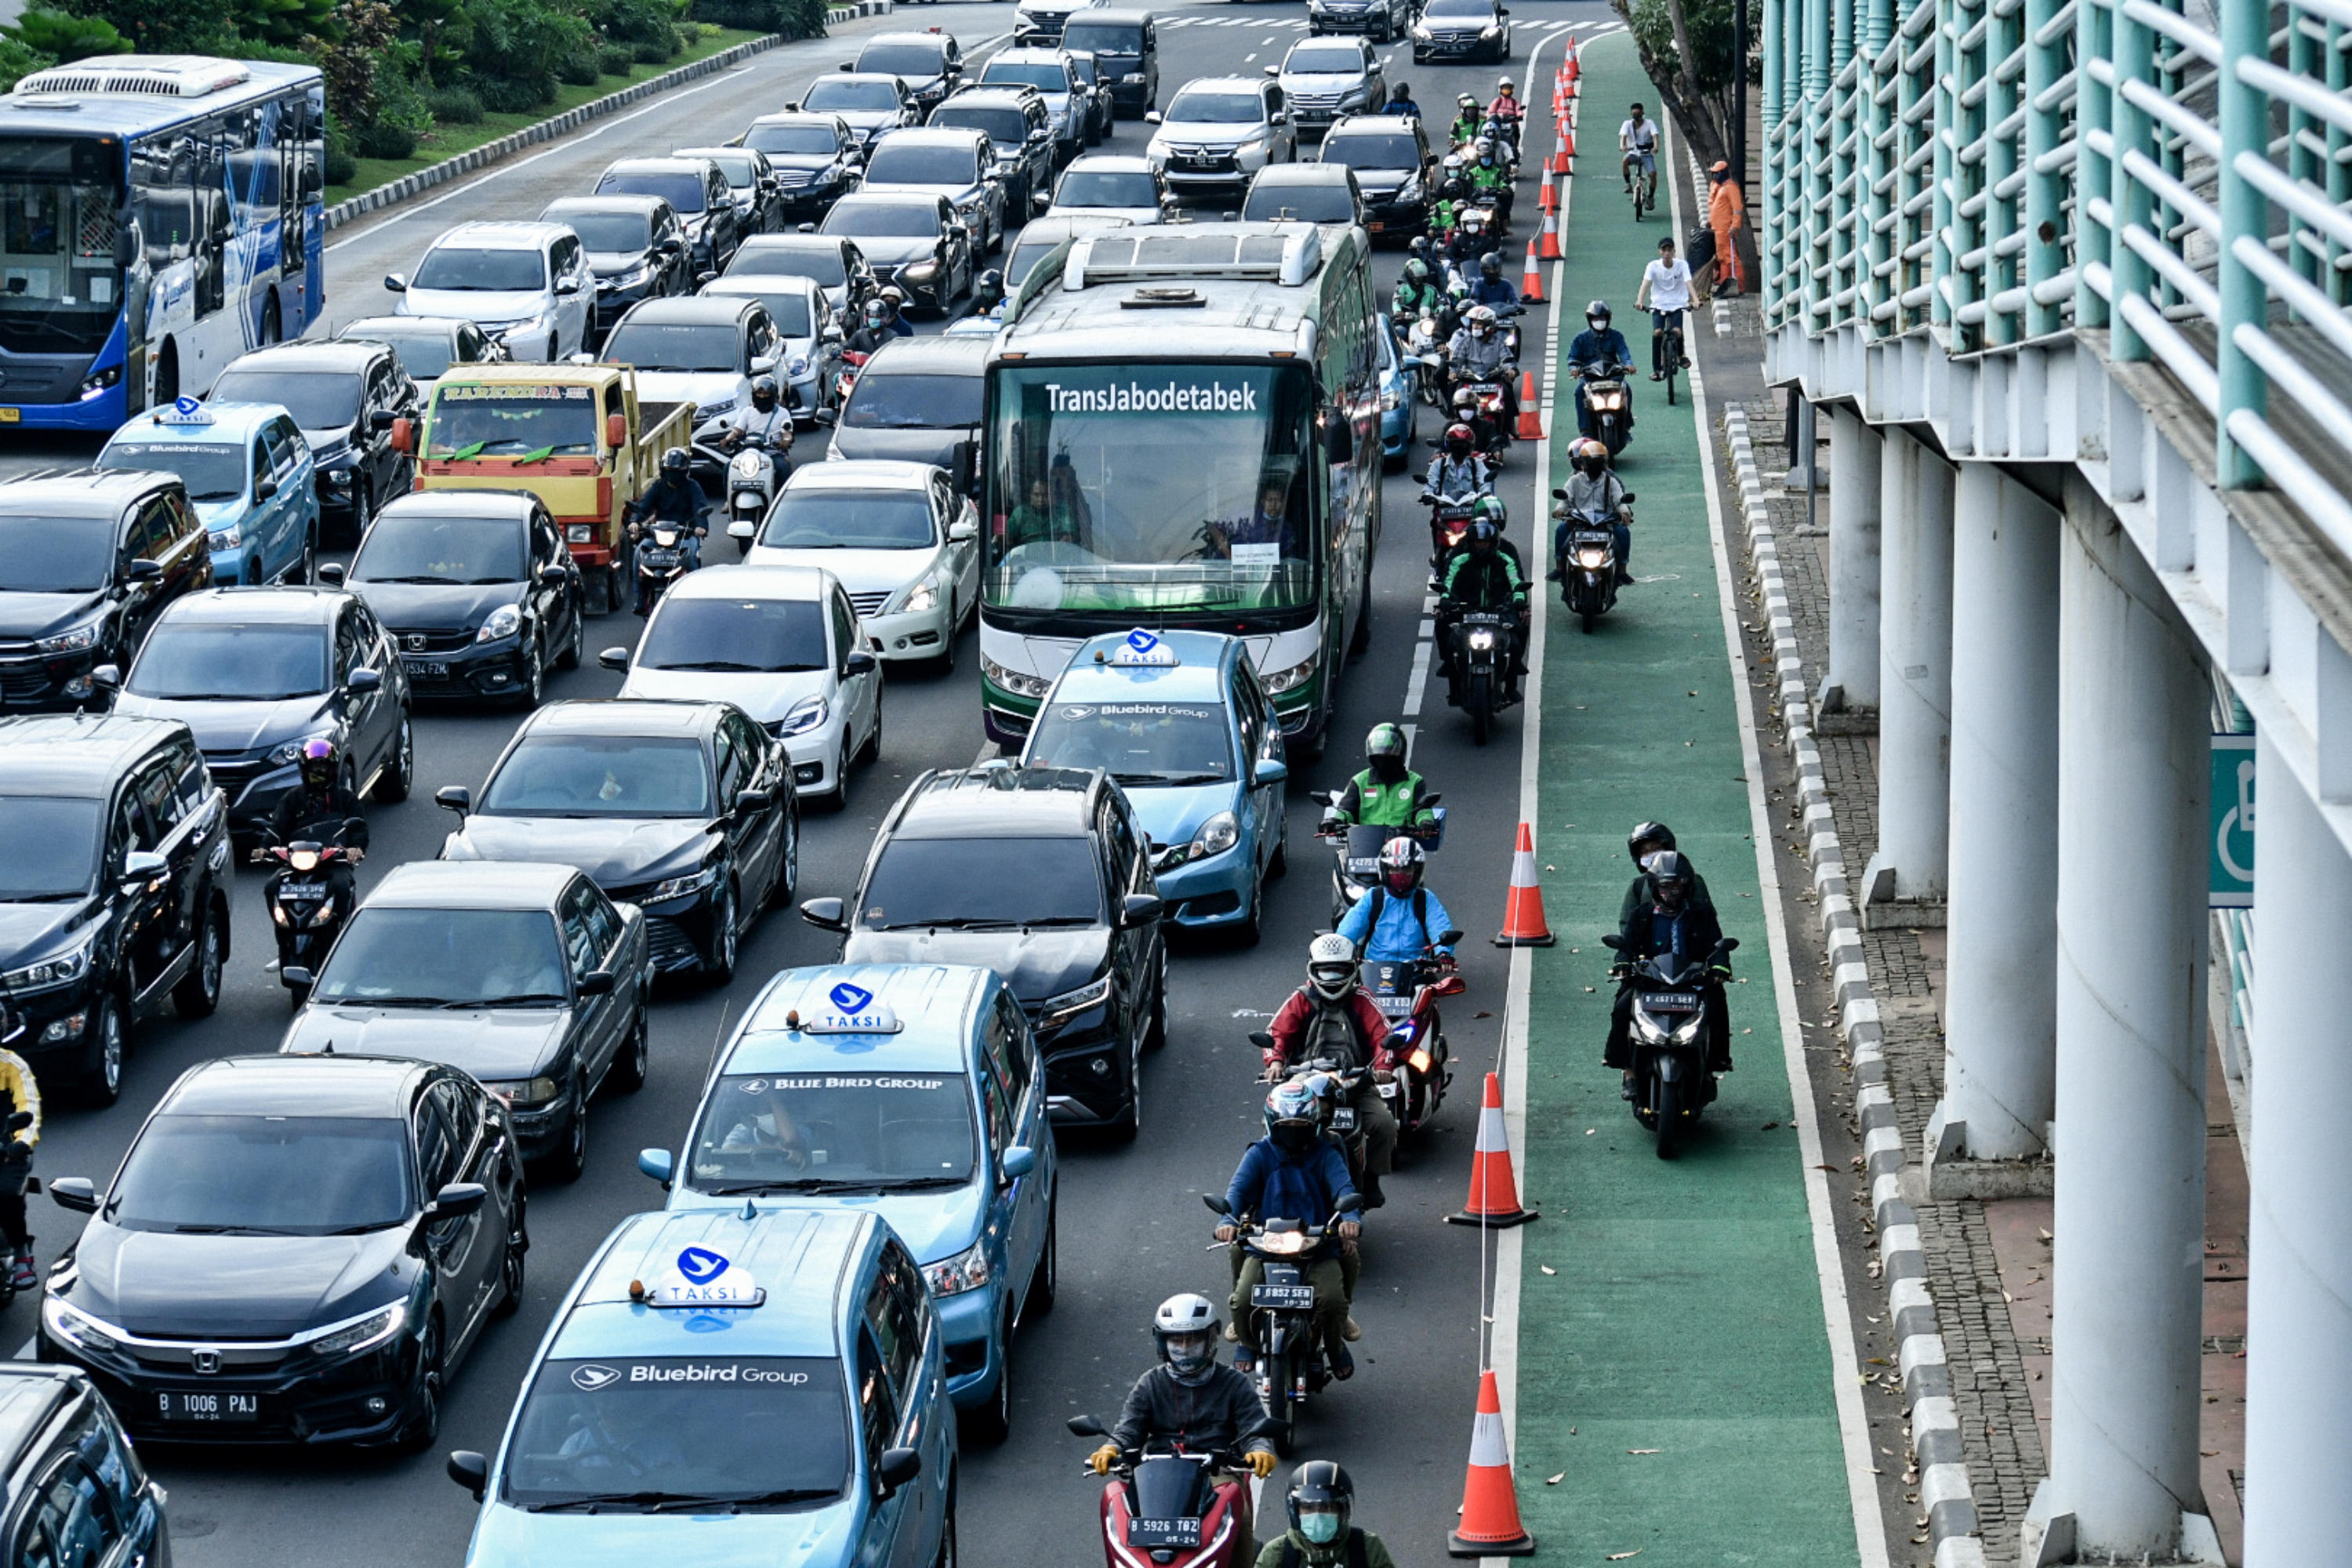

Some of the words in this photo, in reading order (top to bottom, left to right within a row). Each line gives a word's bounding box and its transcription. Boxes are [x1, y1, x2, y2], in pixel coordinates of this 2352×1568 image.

[1045, 381, 1256, 412] TransJabodetabek
[199, 446, 230, 455] Group
[1123, 654, 1163, 662] TAKSI
[1101, 704, 1167, 715] Bluebird
[1168, 706, 1209, 719] Group
[826, 1016, 881, 1028] TAKSI
[775, 1078, 822, 1090] BLUE
[825, 1077, 872, 1088] BIRD
[875, 1077, 943, 1090] GROUP
[671, 1287, 738, 1300] TAKSI
[630, 1365, 739, 1382] Bluebird
[742, 1367, 809, 1386] Group
[159, 1393, 169, 1411] B
[183, 1395, 218, 1412] 1006
[229, 1395, 257, 1413] PAJ
[1131, 1520, 1138, 1532] B
[1143, 1520, 1171, 1532] 5926
[1177, 1520, 1197, 1533] TBZ
[1165, 1535, 1196, 1544] 05-24
